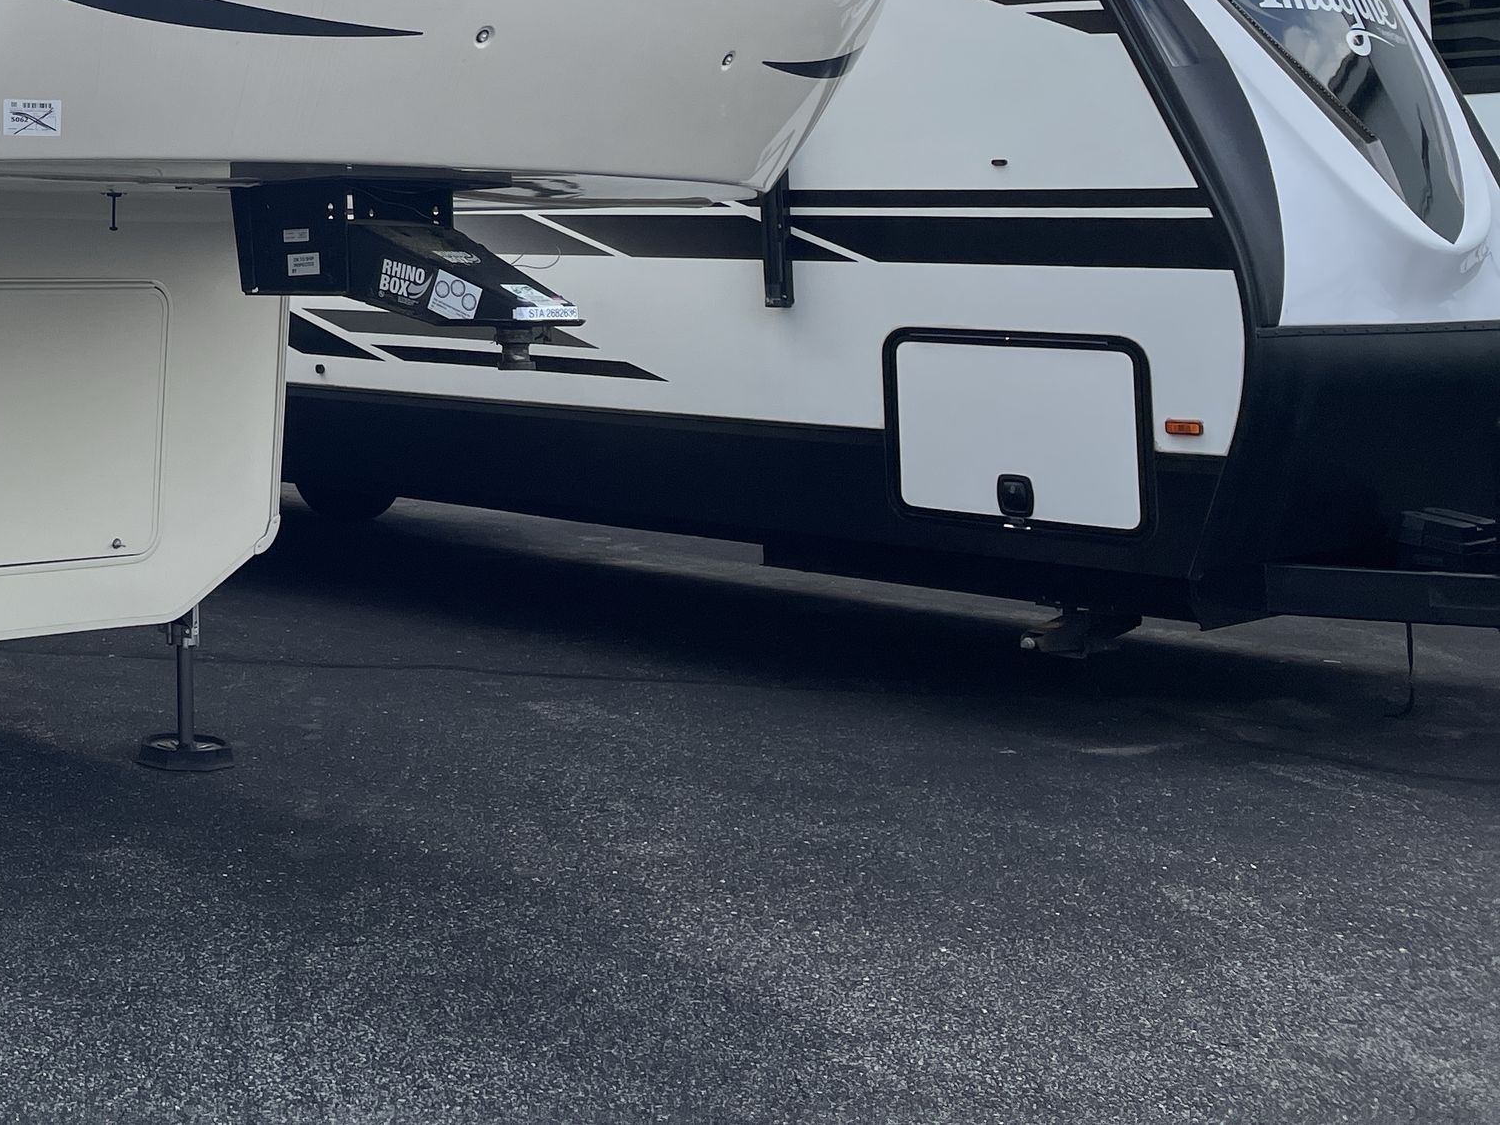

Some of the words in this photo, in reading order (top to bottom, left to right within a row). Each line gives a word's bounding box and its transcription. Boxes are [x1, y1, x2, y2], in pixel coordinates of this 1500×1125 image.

[382, 258, 425, 284] RHINO
[379, 273, 410, 297] BOX
[528, 309, 545, 318] STA
